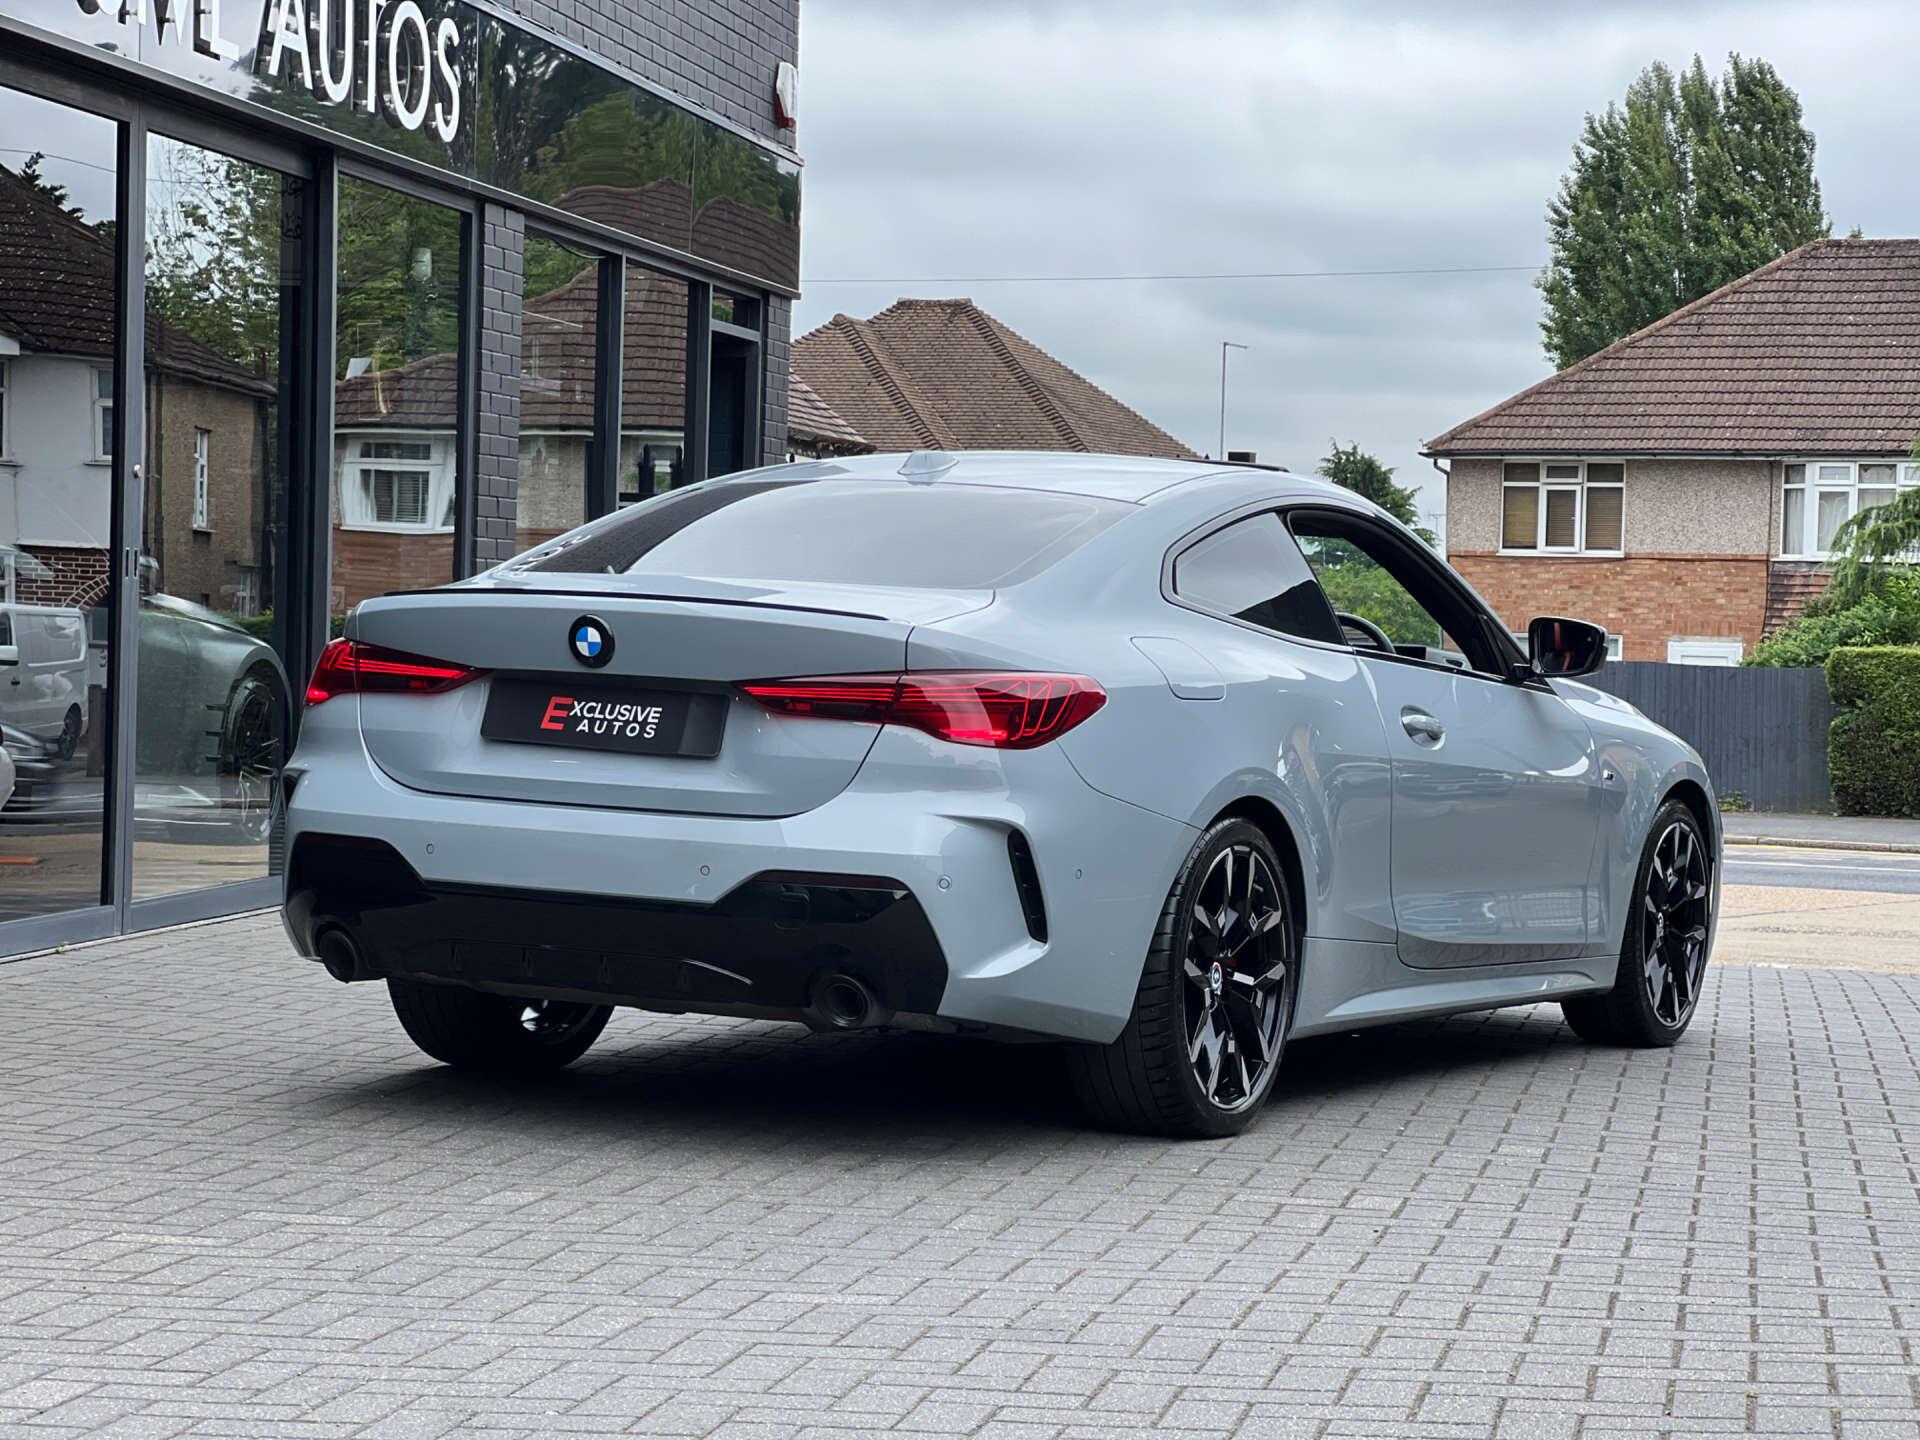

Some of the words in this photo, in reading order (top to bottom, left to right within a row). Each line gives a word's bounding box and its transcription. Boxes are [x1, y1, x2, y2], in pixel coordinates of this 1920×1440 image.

[268, 0, 460, 143] AUTOS
[540, 696, 663, 730] EXCLUSIVE
[575, 719, 657, 738] AUTOS
